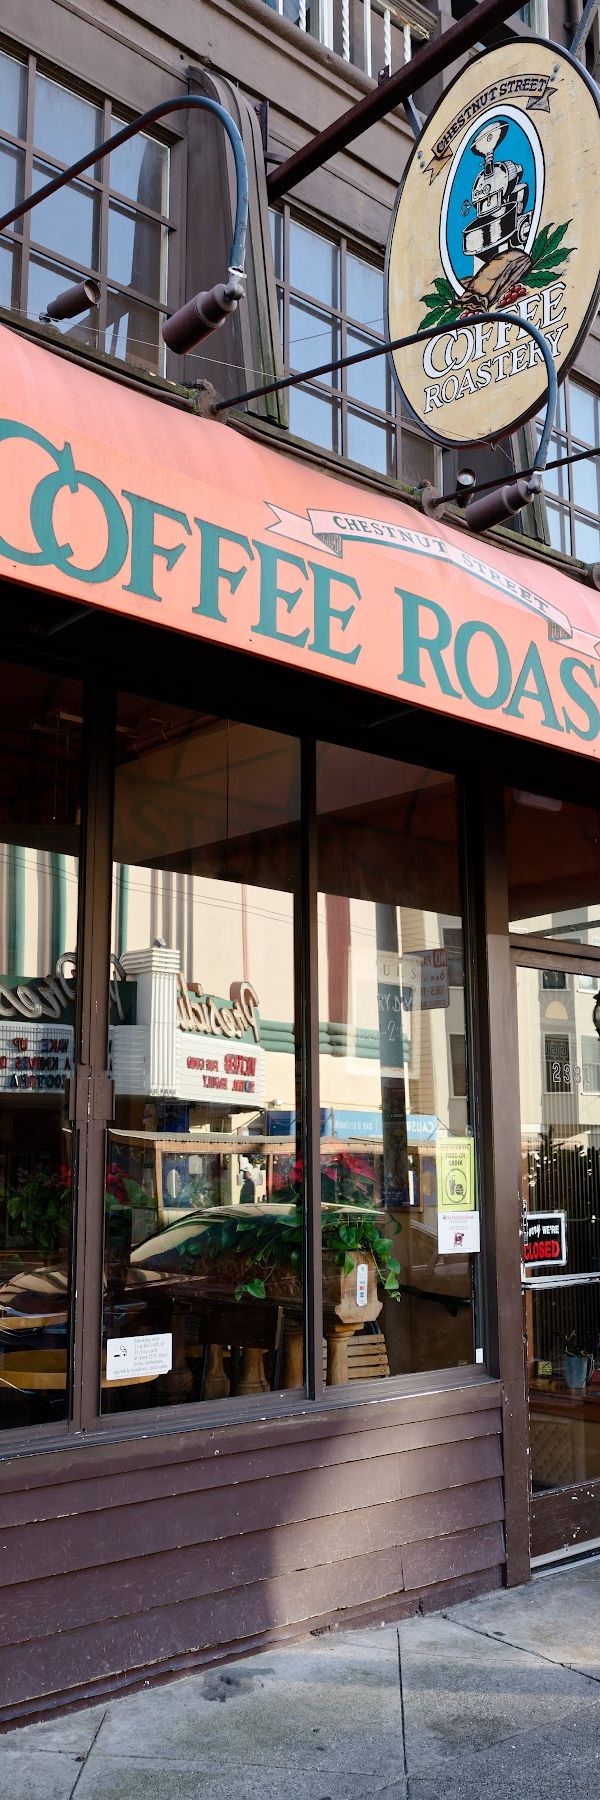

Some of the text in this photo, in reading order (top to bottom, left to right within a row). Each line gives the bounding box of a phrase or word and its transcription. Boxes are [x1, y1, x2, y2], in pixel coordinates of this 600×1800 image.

[436, 78, 549, 154] CHESTNUT STREET
[423, 281, 567, 379] COFFEE
[423, 323, 569, 414] ROASTERY
[0, 418, 362, 665] COFFEE
[333, 515, 549, 613] CHESTNUT STREET
[523, 1240, 560, 1260] CLOSED
[541, 1225, 560, 1234] WE'RE
